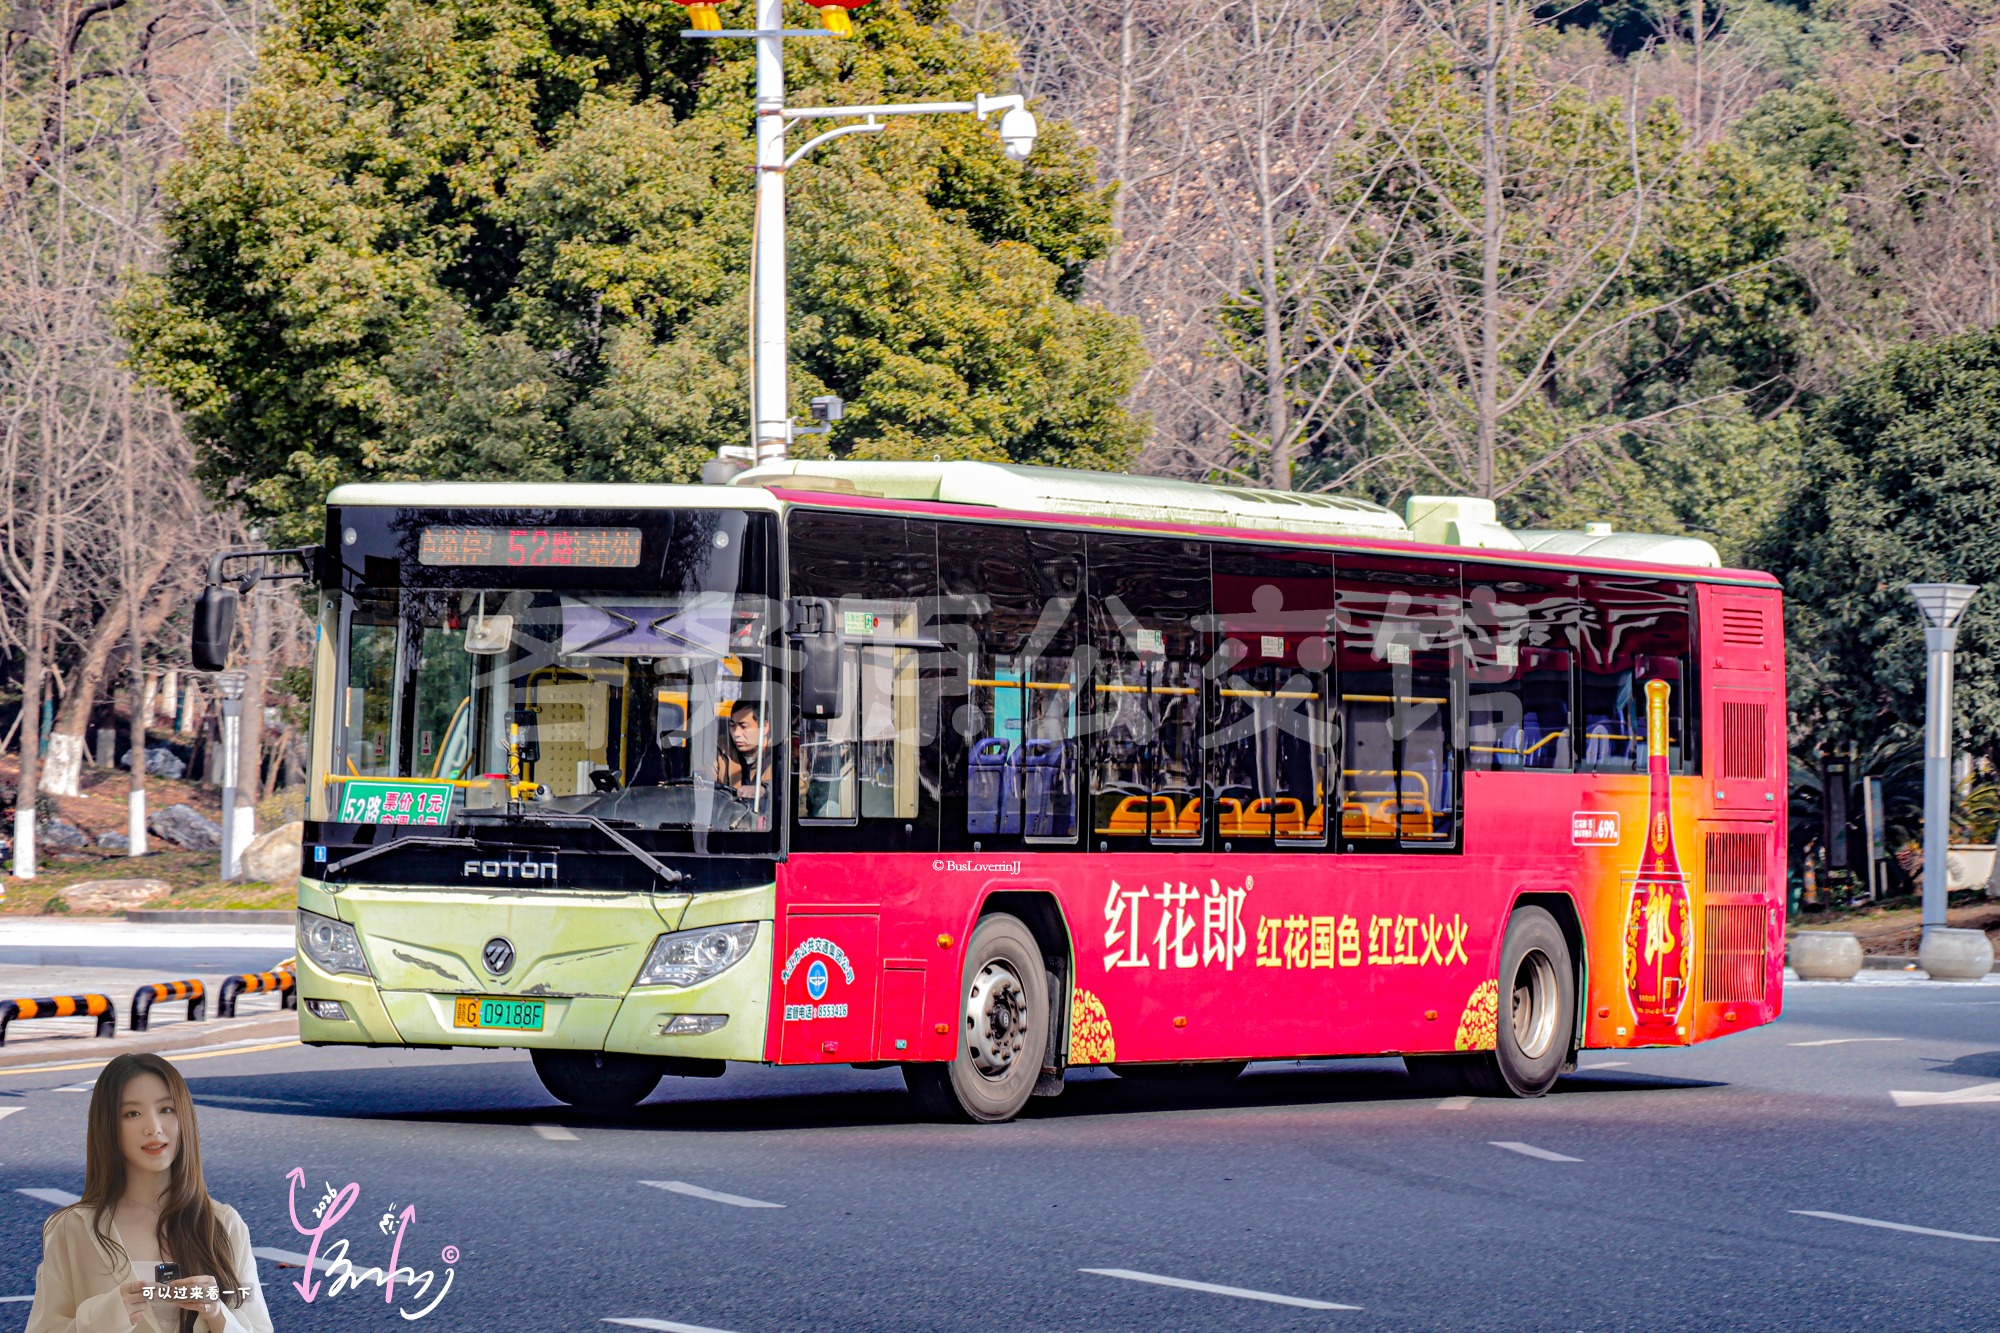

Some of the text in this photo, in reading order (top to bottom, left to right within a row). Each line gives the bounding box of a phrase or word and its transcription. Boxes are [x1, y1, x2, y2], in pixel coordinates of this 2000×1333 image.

[344, 791, 443, 824] 52路 票价 1元
[463, 861, 558, 880] FOTON
[1103, 878, 1470, 973] 红花郎 红花国色 红红火火
[781, 937, 855, 985] 九江市公共交通集团公司
